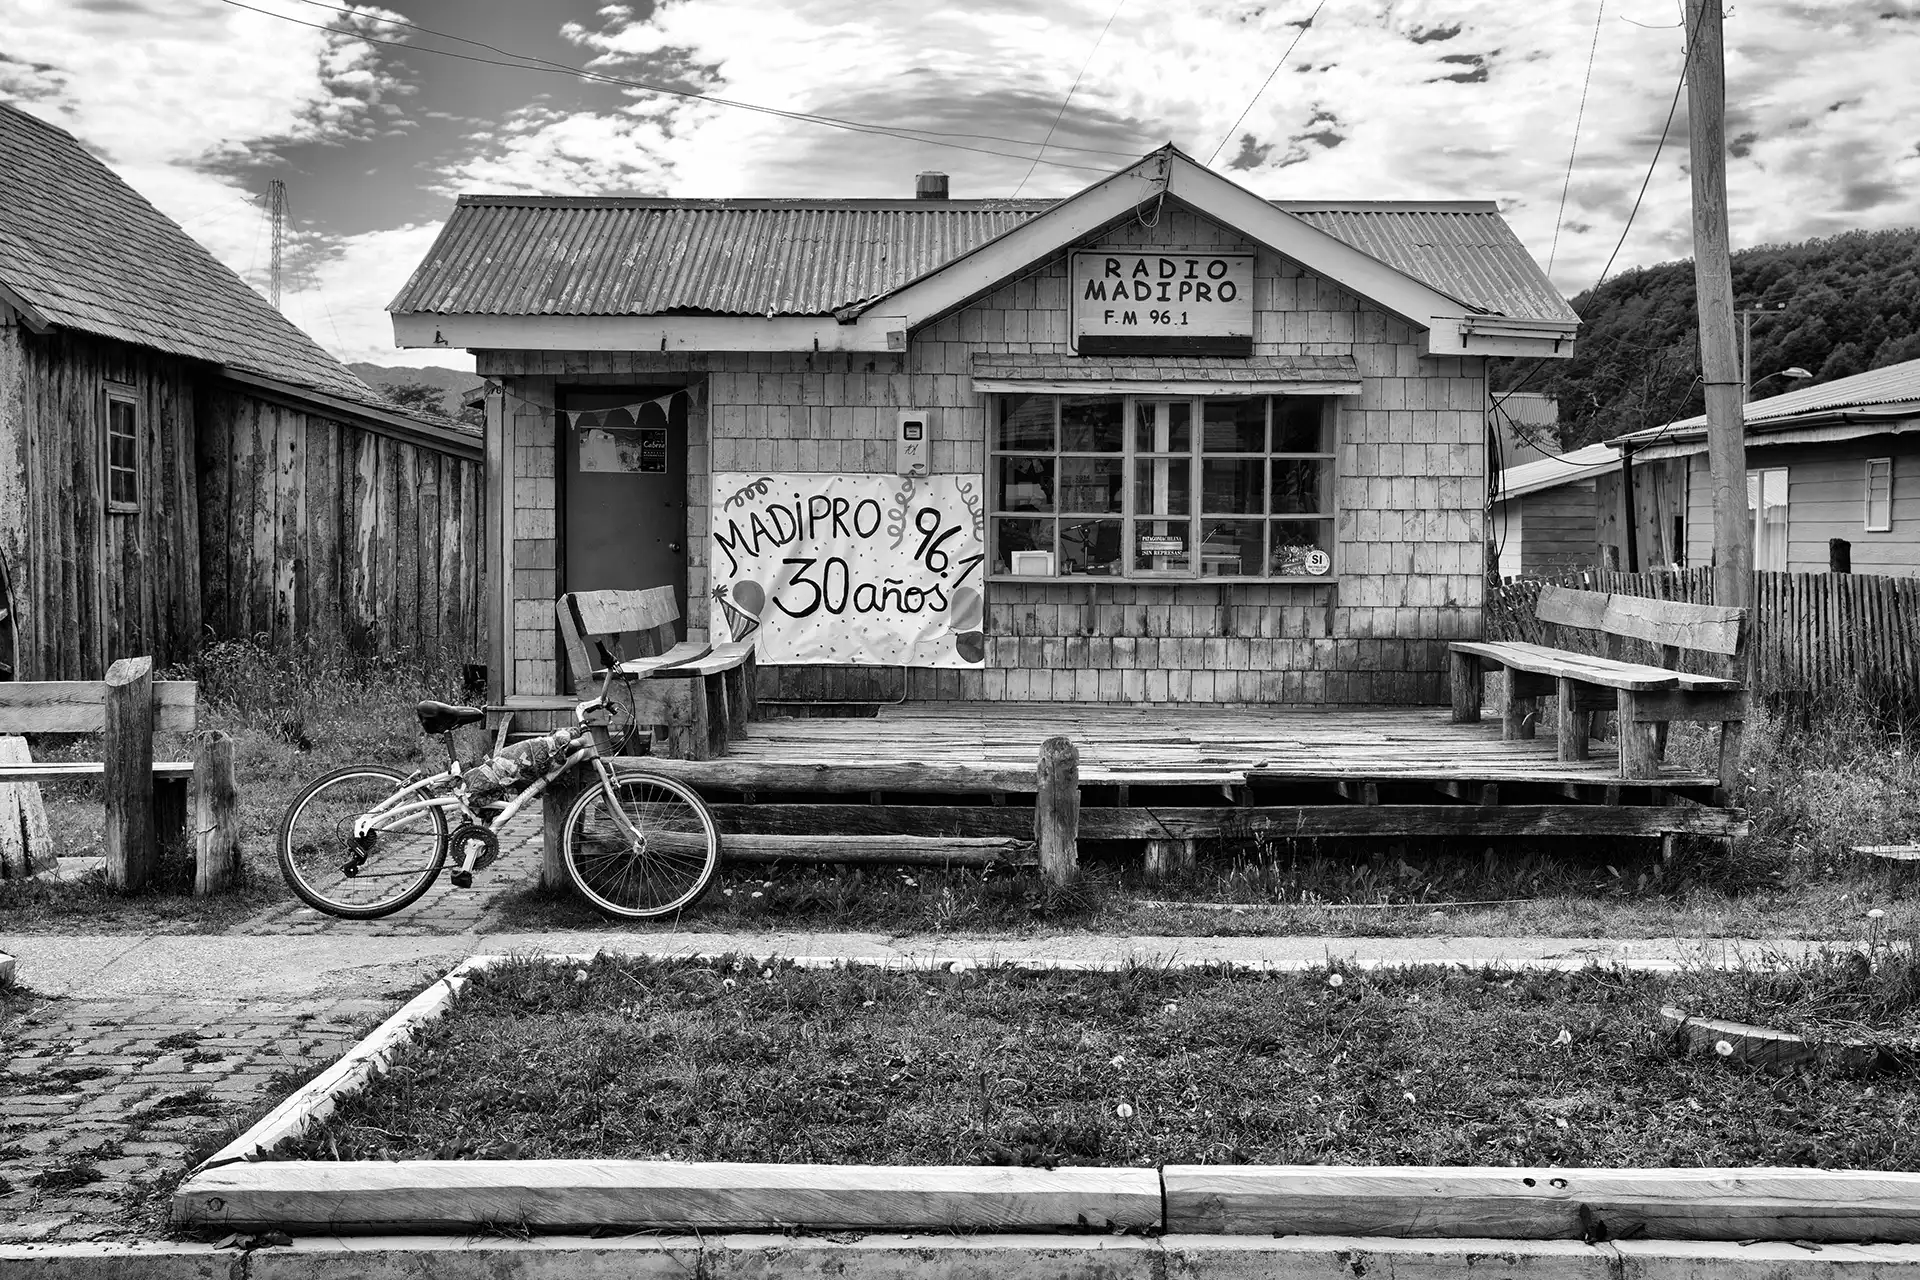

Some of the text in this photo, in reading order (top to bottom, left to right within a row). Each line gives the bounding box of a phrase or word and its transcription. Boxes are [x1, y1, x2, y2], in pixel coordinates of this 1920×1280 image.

[1105, 258, 1228, 280] RADIO
[1084, 279, 1237, 302] MADIPRO
[1104, 310, 1188, 326] F.M 96.1
[1311, 554, 1323, 565] SI
[772, 557, 948, 619] 30 años
